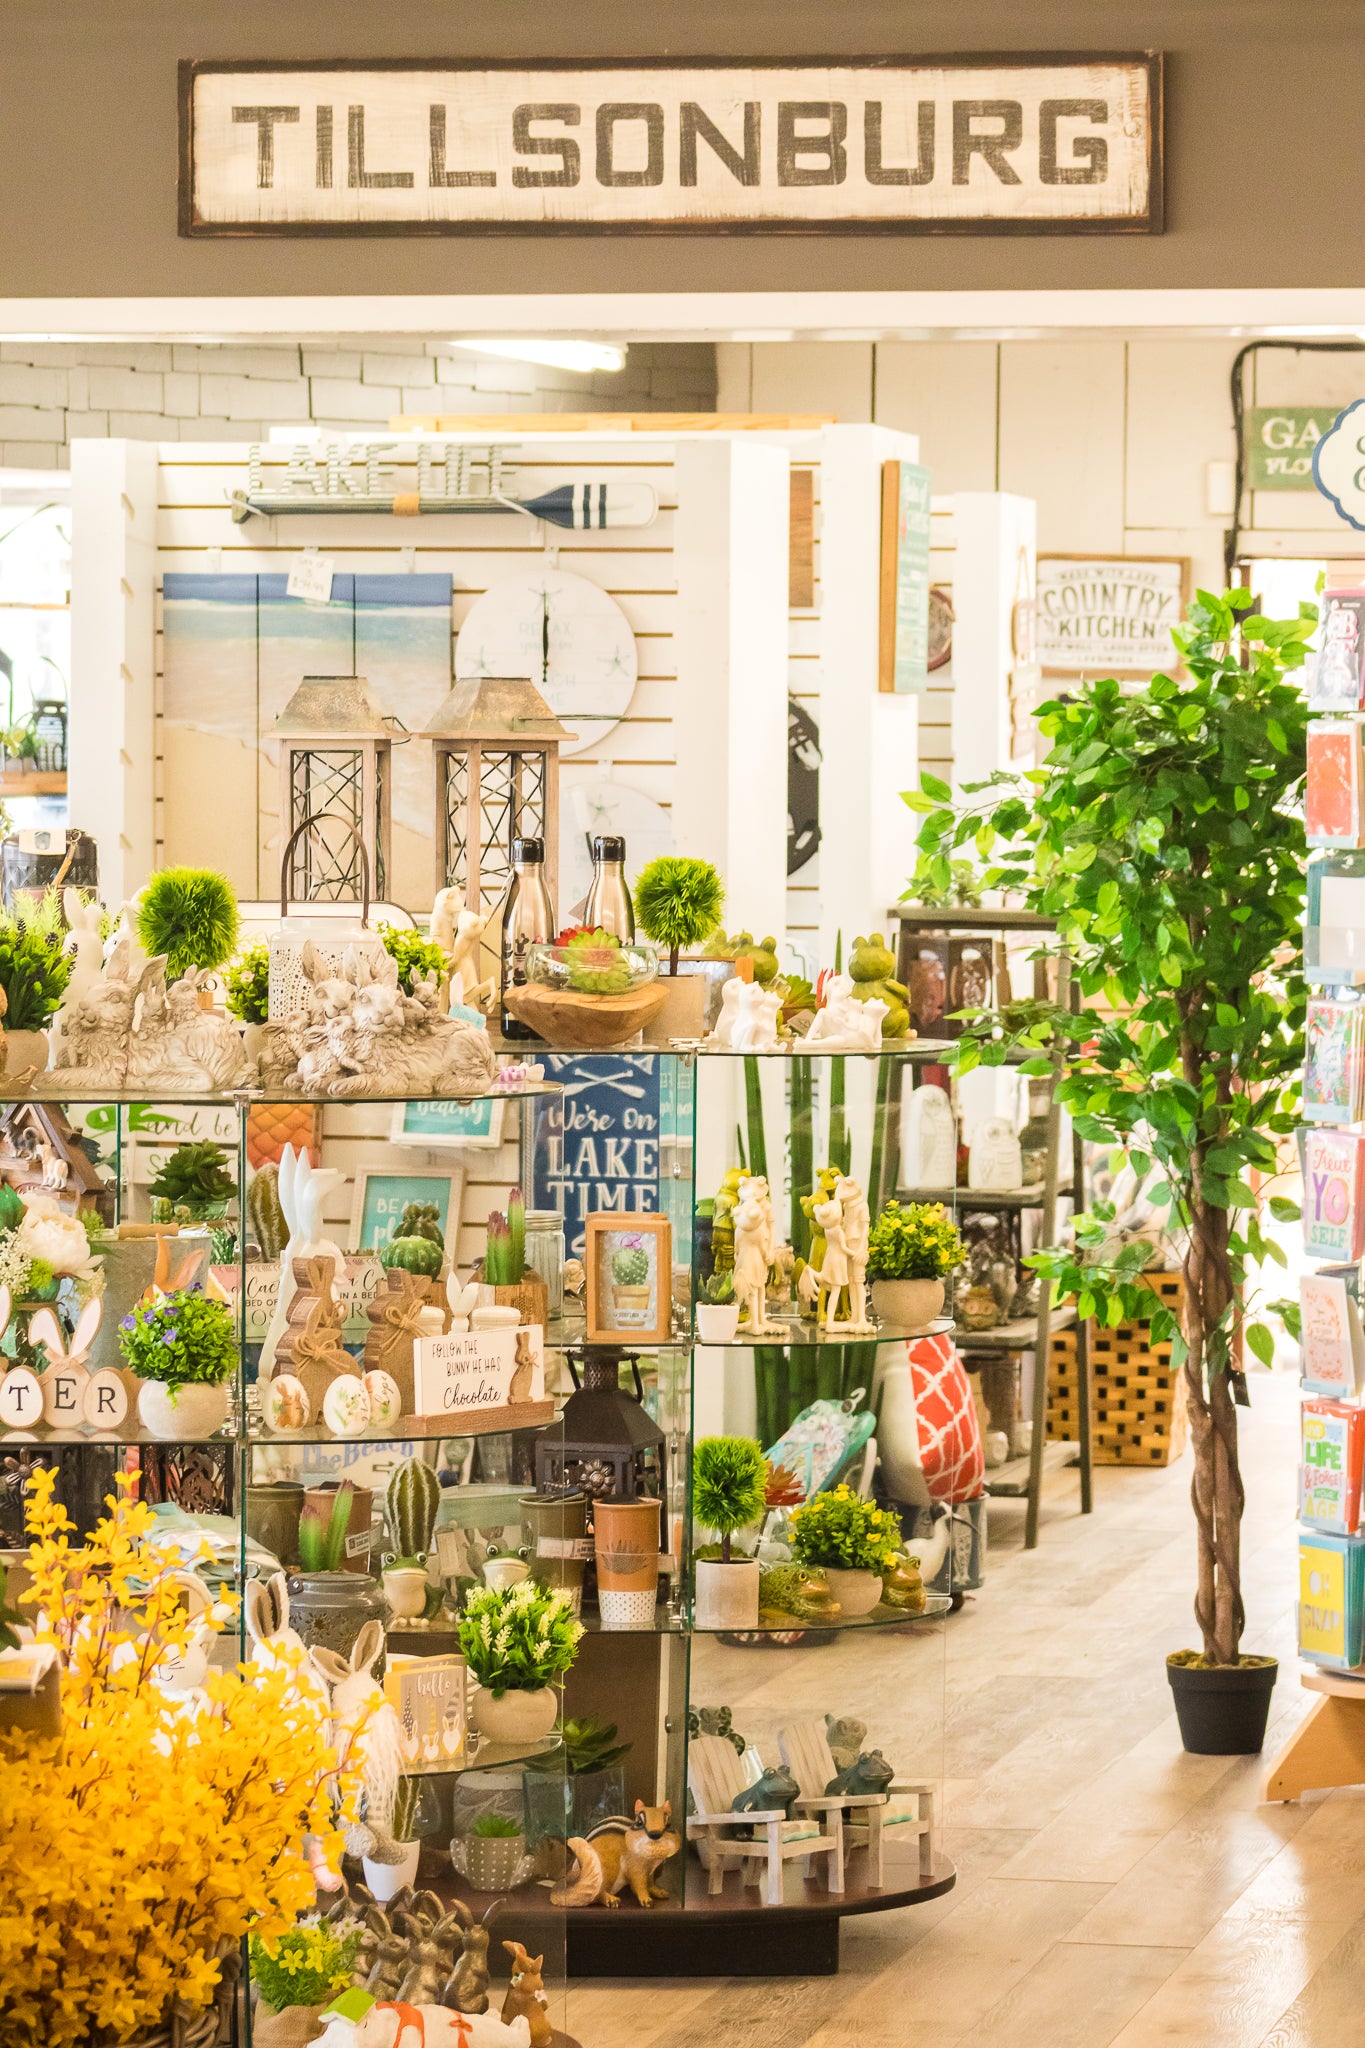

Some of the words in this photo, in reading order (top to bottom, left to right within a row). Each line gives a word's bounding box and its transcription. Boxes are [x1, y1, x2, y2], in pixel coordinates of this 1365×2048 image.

[231, 100, 1109, 189] TILLSONBURG
[1261, 417, 1337, 451] GA
[249, 443, 398, 496] LAKE
[417, 443, 523, 499] LIFE
[1043, 583, 1173, 619] COUNTRY
[518, 622, 572, 637] REAX
[1058, 615, 1156, 639] KITCHEN
[213, 1112, 234, 1137] be
[548, 1100, 615, 1133] We're
[623, 1107, 657, 1132] On
[547, 1135, 658, 1180] LAKE
[546, 1181, 658, 1222] TIME
[1312, 1171, 1350, 1226] YO
[1310, 1224, 1347, 1249] SELF
[352, 1291, 358, 1300] A
[431, 1341, 463, 1358] FOLLOW
[464, 1339, 478, 1356] THE
[446, 1360, 470, 1377] BUNNY
[472, 1358, 482, 1374] HE
[485, 1356, 502, 1373] HAS
[443, 1379, 502, 1410] Chocolate
[1305, 1440, 1342, 1471] LIFE
[1305, 1493, 1338, 1519] AGE
[1303, 1603, 1340, 1633] SNAP
[416, 1671, 451, 1698] hello
